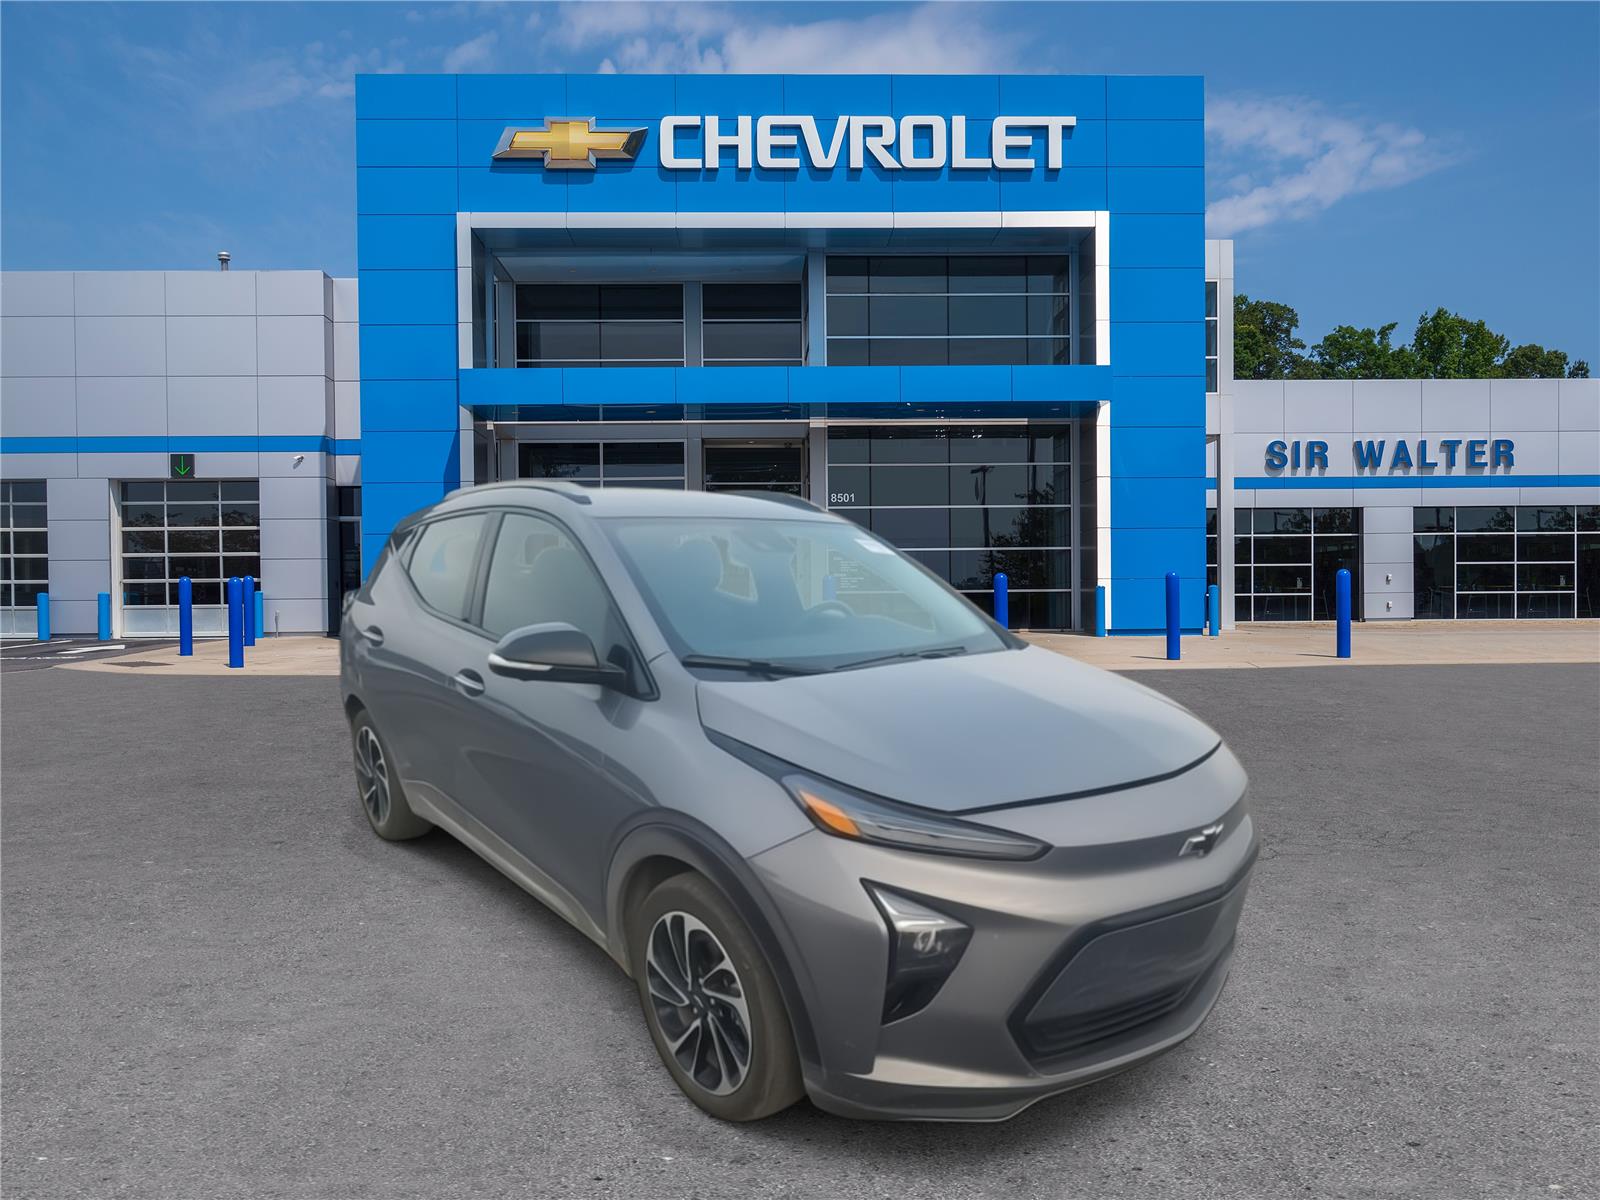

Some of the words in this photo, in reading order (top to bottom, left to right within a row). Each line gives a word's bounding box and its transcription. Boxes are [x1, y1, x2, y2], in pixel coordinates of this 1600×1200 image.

[659, 115, 1077, 170] CHEVROLET
[1265, 439, 1329, 470] SIR
[1354, 438, 1516, 468] WALTER
[830, 493, 855, 503] 8501
